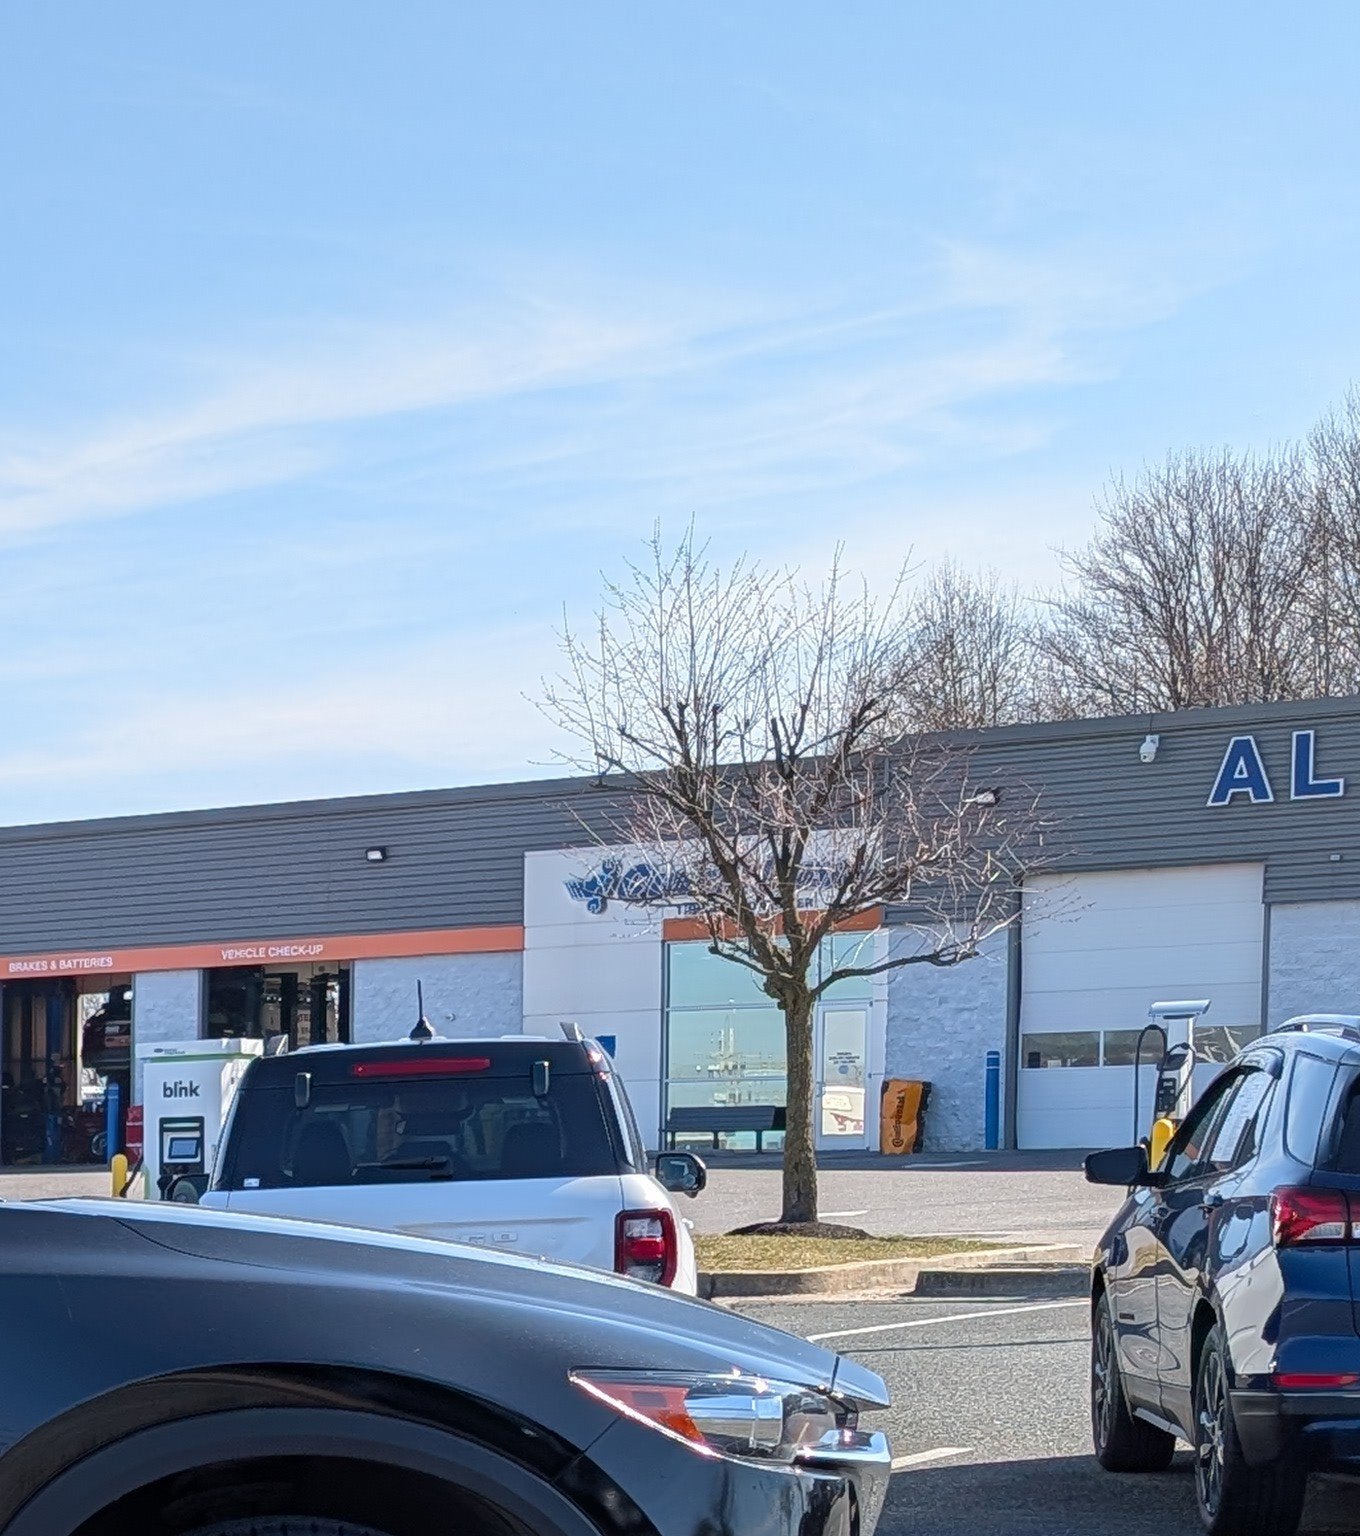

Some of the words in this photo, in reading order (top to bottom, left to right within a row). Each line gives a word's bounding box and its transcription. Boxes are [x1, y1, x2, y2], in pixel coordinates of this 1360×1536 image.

[1206, 729, 1344, 807] AL
[221, 947, 266, 960] VEHICLE
[268, 944, 324, 957] CHECK-UP
[8, 960, 48, 973] BRAKES
[50, 959, 57, 970] &
[59, 956, 114, 970] BATTERIES
[163, 1080, 200, 1098] blink
